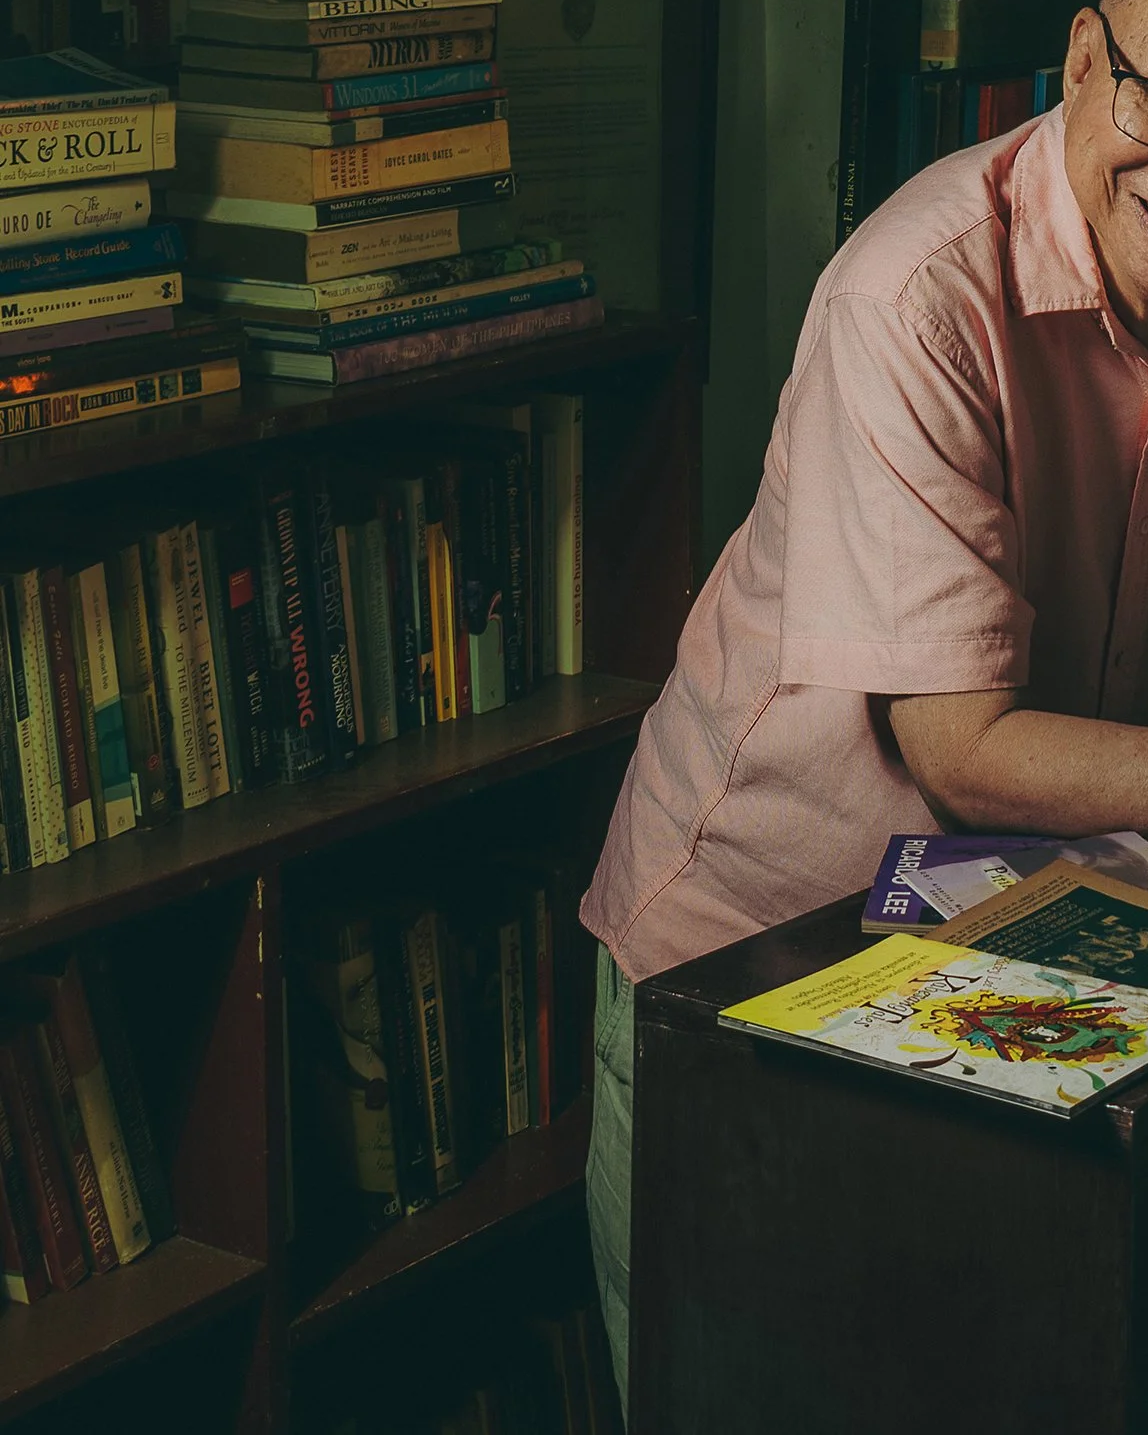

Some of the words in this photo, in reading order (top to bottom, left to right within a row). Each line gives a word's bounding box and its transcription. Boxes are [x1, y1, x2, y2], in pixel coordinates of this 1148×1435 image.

[318, 22, 387, 40] VITTORINI
[17, 120, 60, 134] STONE
[62, 116, 129, 130] ENCYCLOPEDIA
[37, 137, 58, 163] &
[64, 128, 142, 160] ROLL
[384, 155, 406, 168] JOYCE
[408, 152, 431, 165] CAROL
[432, 149, 454, 162] OATES
[74, 209, 123, 228] Changeling
[185, 558, 205, 630] JEWEL
[198, 661, 217, 711] BRET
[288, 623, 315, 728] WRONG
[205, 723, 223, 772] LOTT
[882, 892, 911, 916] LEE
